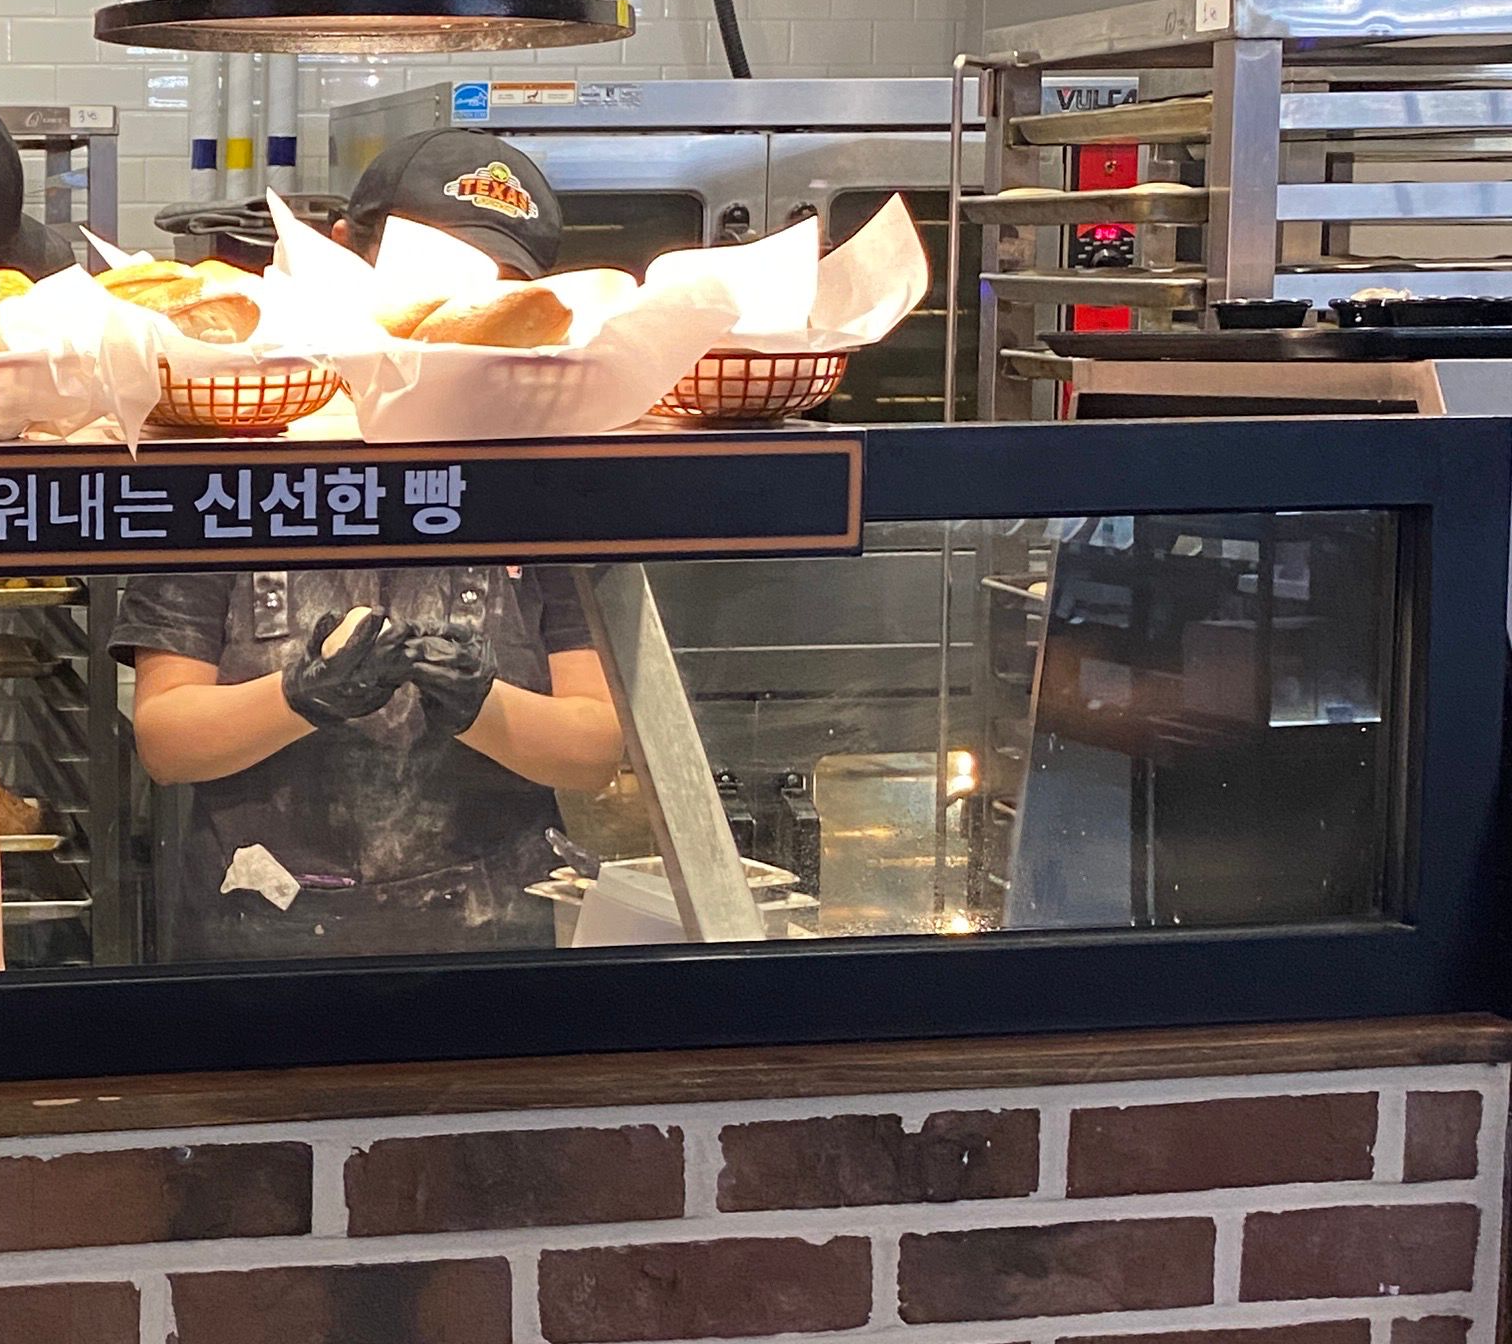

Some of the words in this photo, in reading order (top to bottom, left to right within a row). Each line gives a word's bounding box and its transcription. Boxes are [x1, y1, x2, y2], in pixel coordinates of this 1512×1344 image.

[460, 178, 529, 213] TEXAS
[194, 467, 387, 539] 신선한
[404, 465, 466, 535] 빵
